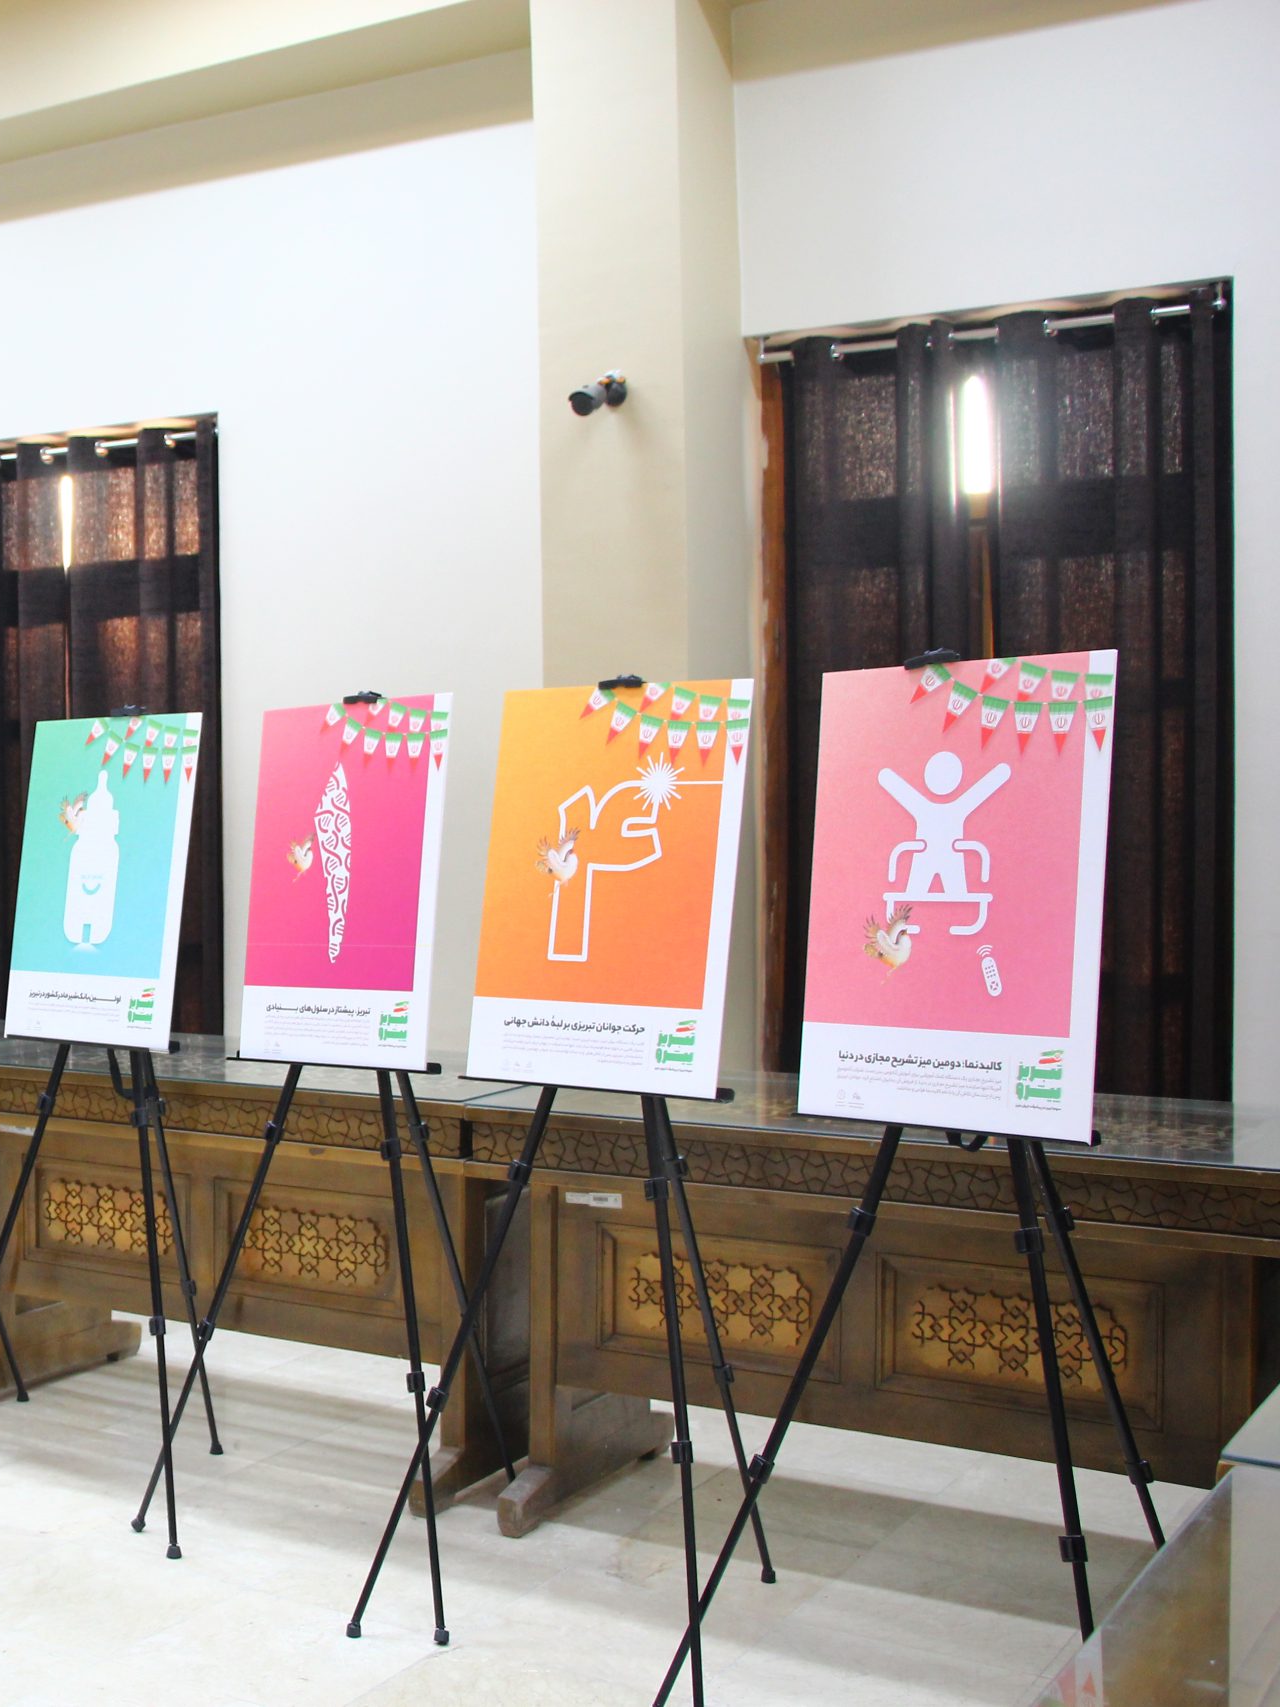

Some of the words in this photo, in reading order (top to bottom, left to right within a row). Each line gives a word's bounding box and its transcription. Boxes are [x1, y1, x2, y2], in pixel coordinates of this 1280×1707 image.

[327, 1006, 335, 1015] در
[334, 1005, 355, 1017] پیشتاز
[503, 1016, 527, 1028] جهانی
[527, 1016, 550, 1028] دانش
[562, 1021, 571, 1031] بر
[570, 1020, 596, 1033] تبریزی
[595, 1021, 622, 1035] جوانان
[622, 1023, 645, 1035] حرکت
[838, 1050, 854, 1062] دنیا
[854, 1053, 864, 1063] در
[864, 1052, 891, 1065] مجازی
[890, 1053, 918, 1068] تشریح
[917, 1056, 932, 1069] میز
[932, 1058, 962, 1071] دومین
